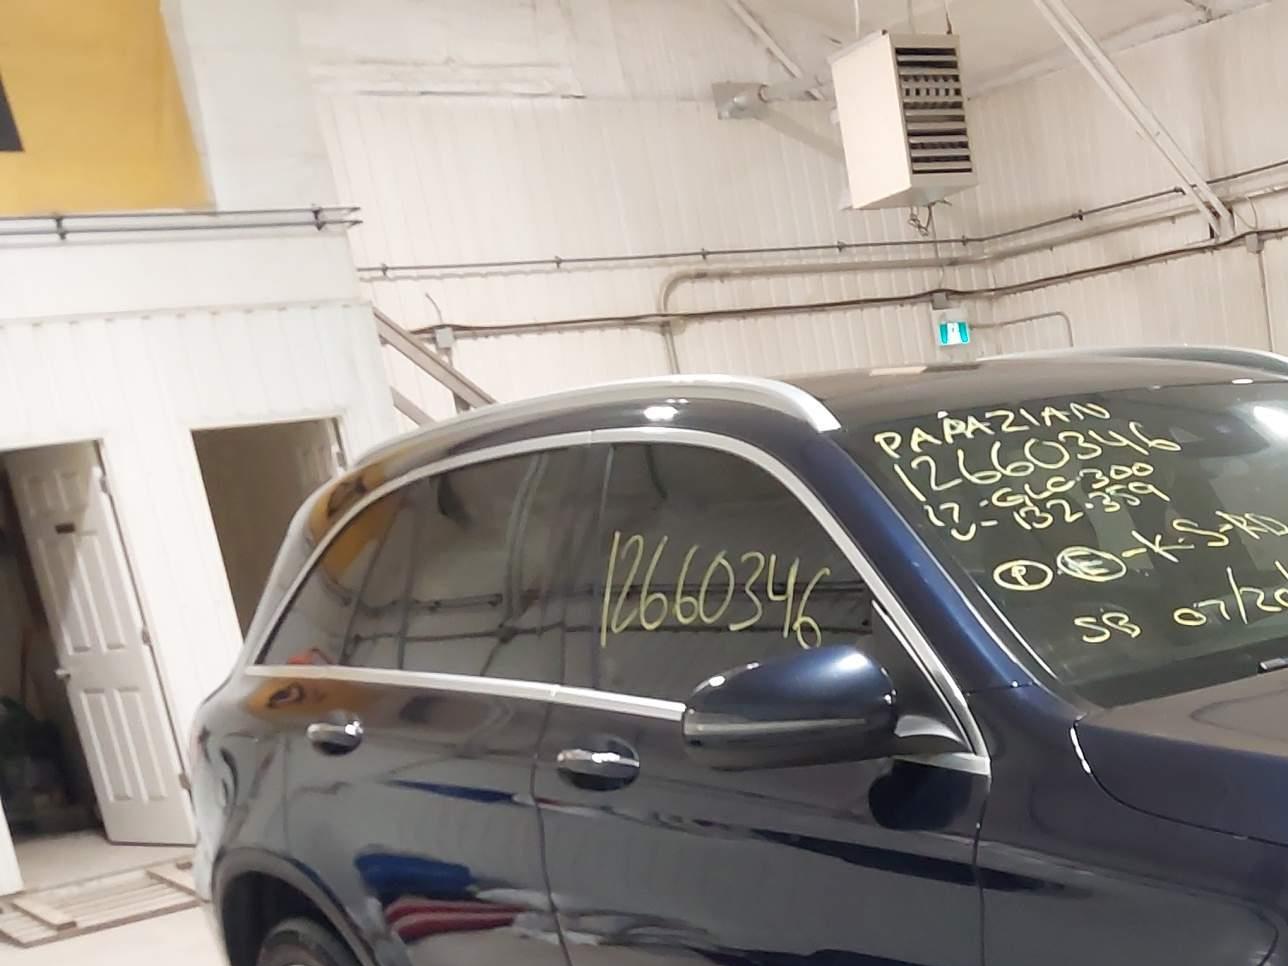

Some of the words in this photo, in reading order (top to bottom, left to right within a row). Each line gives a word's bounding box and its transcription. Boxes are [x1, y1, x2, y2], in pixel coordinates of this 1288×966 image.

[874, 402, 1111, 458] PAPAZIAN
[893, 421, 1183, 502] 12660346
[600, 530, 831, 650] 12660346
[1073, 607, 1142, 643] SB
